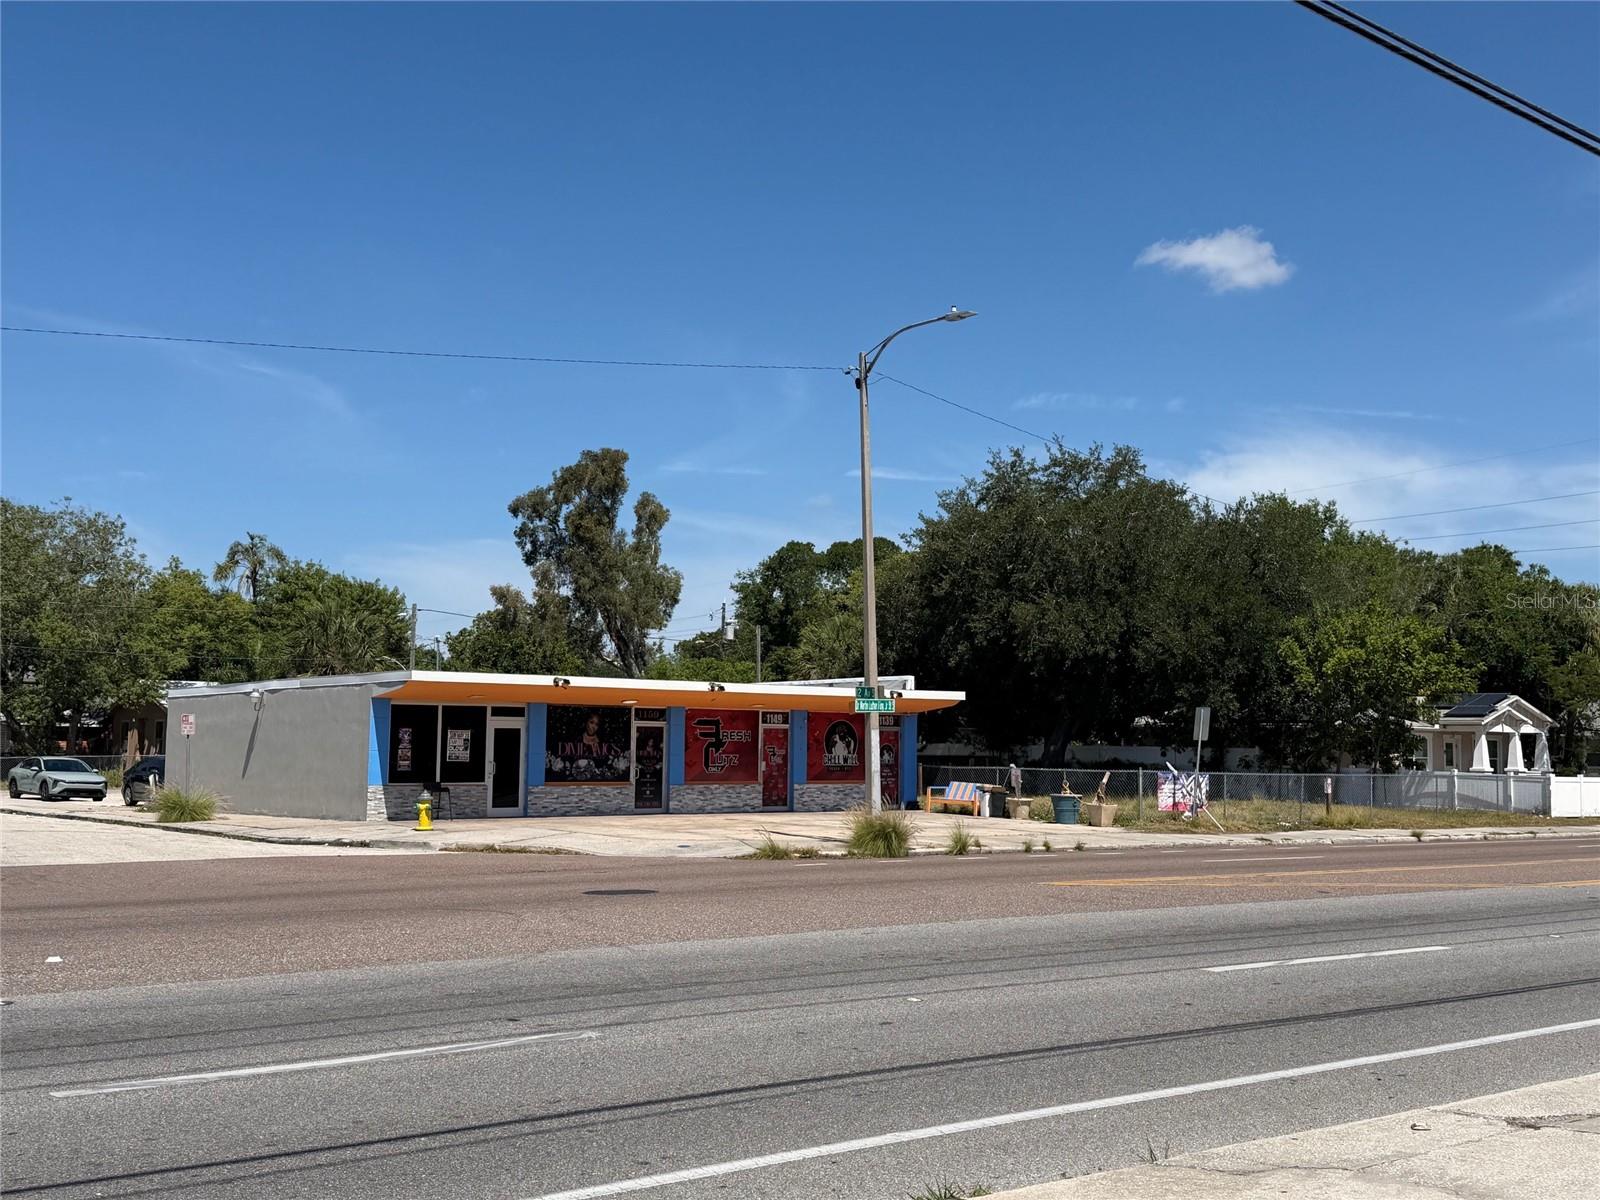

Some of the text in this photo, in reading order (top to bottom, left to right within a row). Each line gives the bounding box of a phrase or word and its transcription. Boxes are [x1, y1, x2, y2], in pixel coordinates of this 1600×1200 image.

[692, 716, 752, 742] FRESH
[766, 714, 783, 724] 1149
[703, 740, 740, 773] CUTZ
